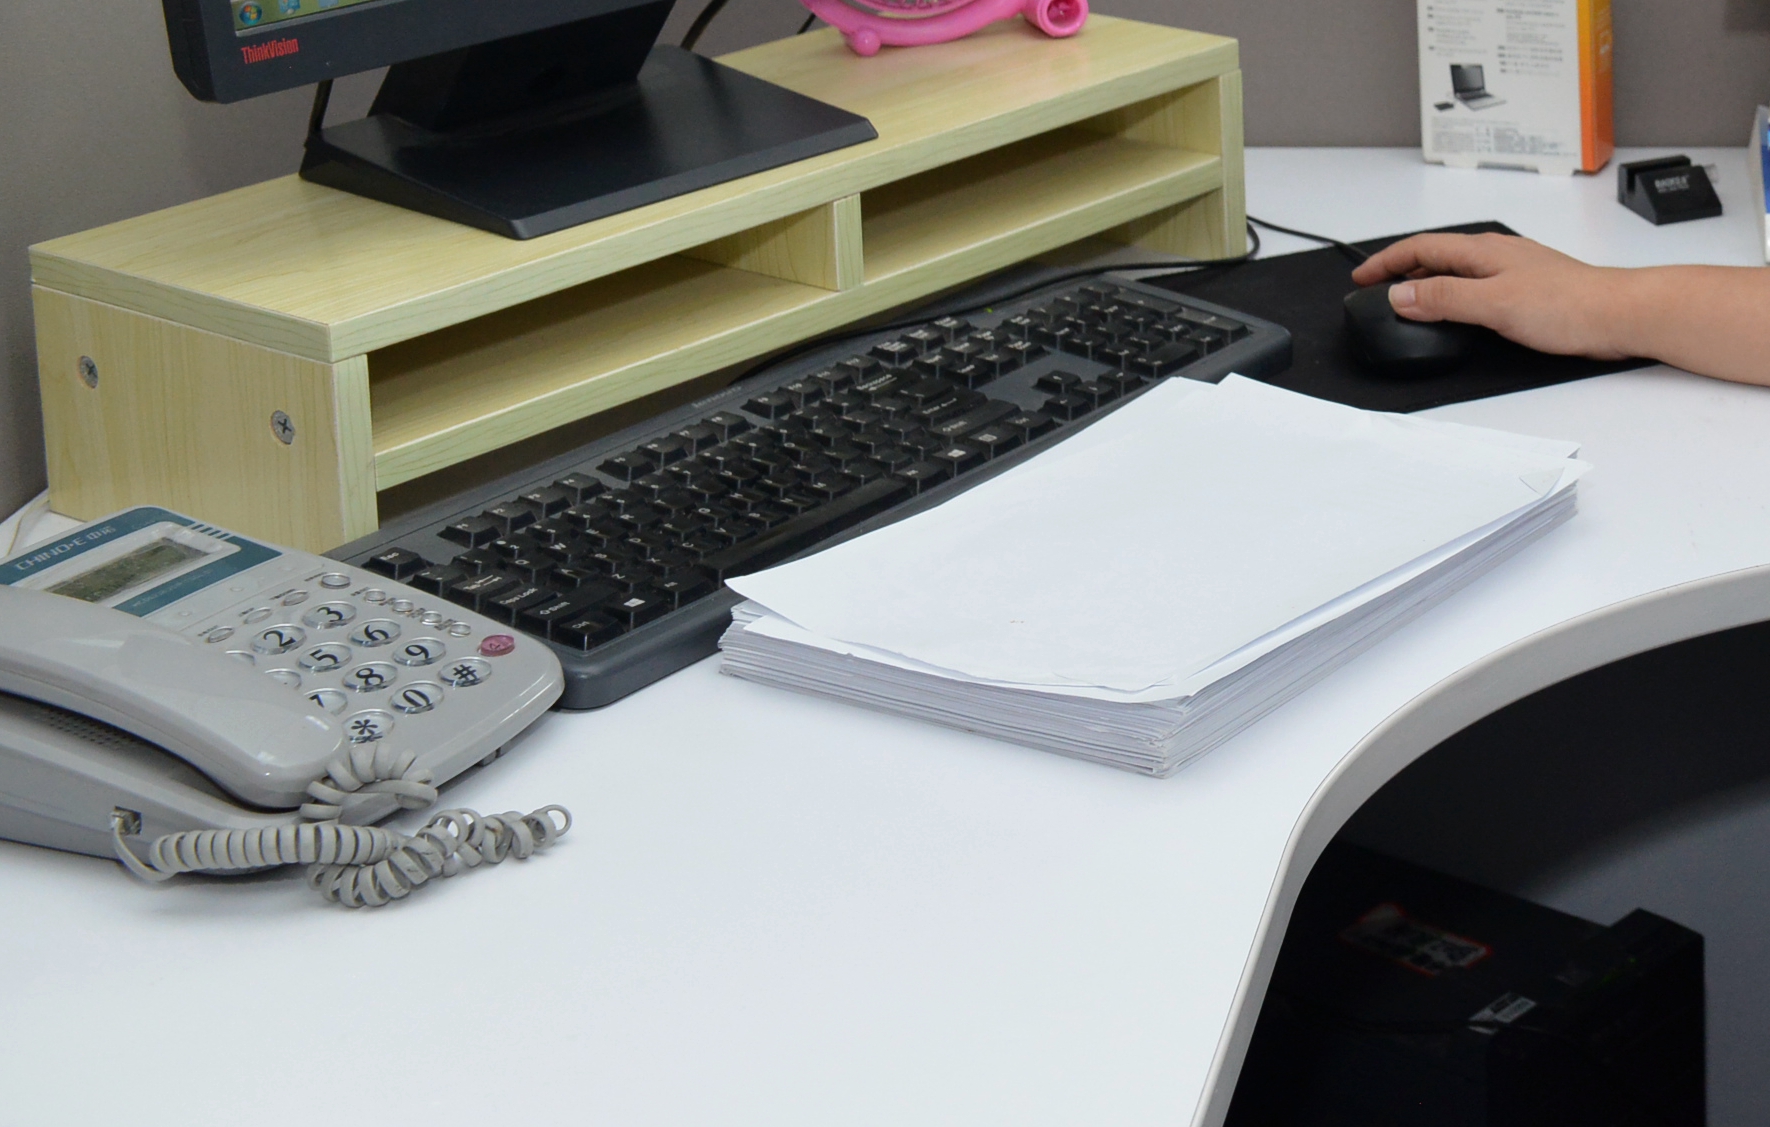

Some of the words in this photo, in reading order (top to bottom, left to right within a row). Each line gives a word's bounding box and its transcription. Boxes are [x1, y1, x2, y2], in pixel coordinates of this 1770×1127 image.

[240, 37, 299, 64] ThinkVision
[317, 605, 344, 623] 3
[263, 629, 297, 648] 2
[364, 624, 390, 642] 6
[309, 648, 339, 666] 5
[404, 644, 431, 662] 9
[355, 667, 386, 687] 8
[402, 688, 432, 709] 0
